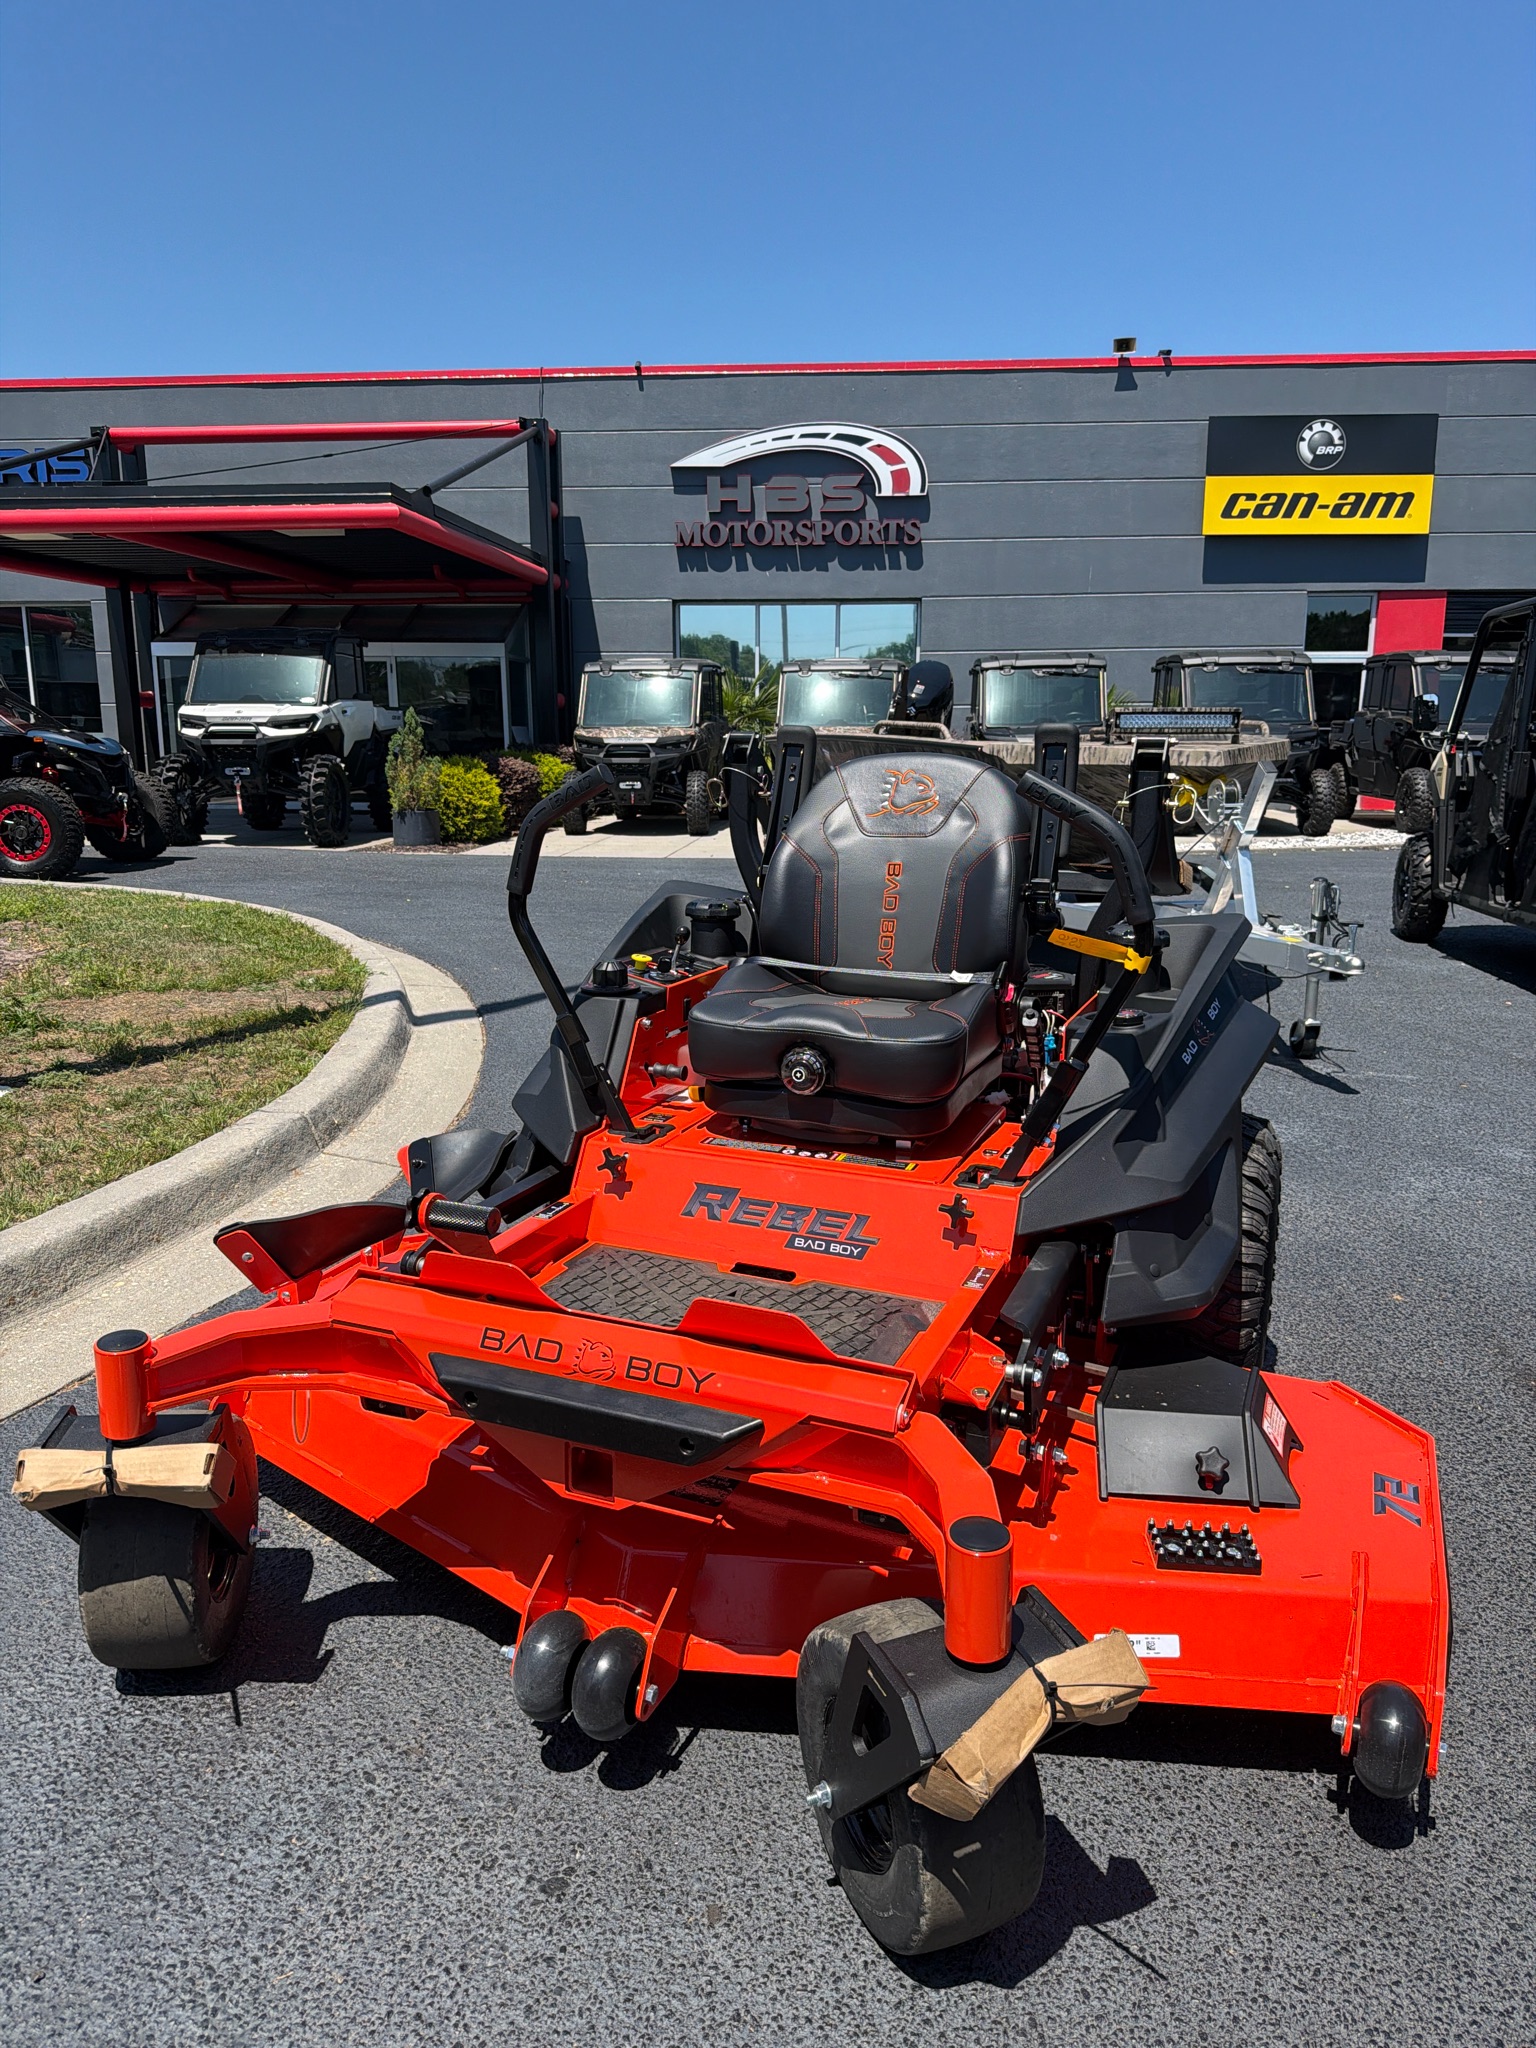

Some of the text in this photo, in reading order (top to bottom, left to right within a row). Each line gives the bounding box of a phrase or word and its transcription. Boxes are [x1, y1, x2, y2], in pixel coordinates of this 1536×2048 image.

[1315, 446, 1343, 455] BRP
[706, 473, 865, 513] HBS
[1220, 491, 1415, 519] can-am
[674, 518, 922, 548] MOTORSPORTS
[548, 775, 592, 811] BAD
[1025, 782, 1090, 820] BOY
[877, 861, 902, 969] BAD BOY
[1181, 998, 1221, 1065] BAD BOY
[680, 1181, 881, 1246] REBEL
[794, 1237, 862, 1256] BAD BOY
[479, 1326, 716, 1393] BAD BOY
[1373, 1472, 1421, 1527] 72
